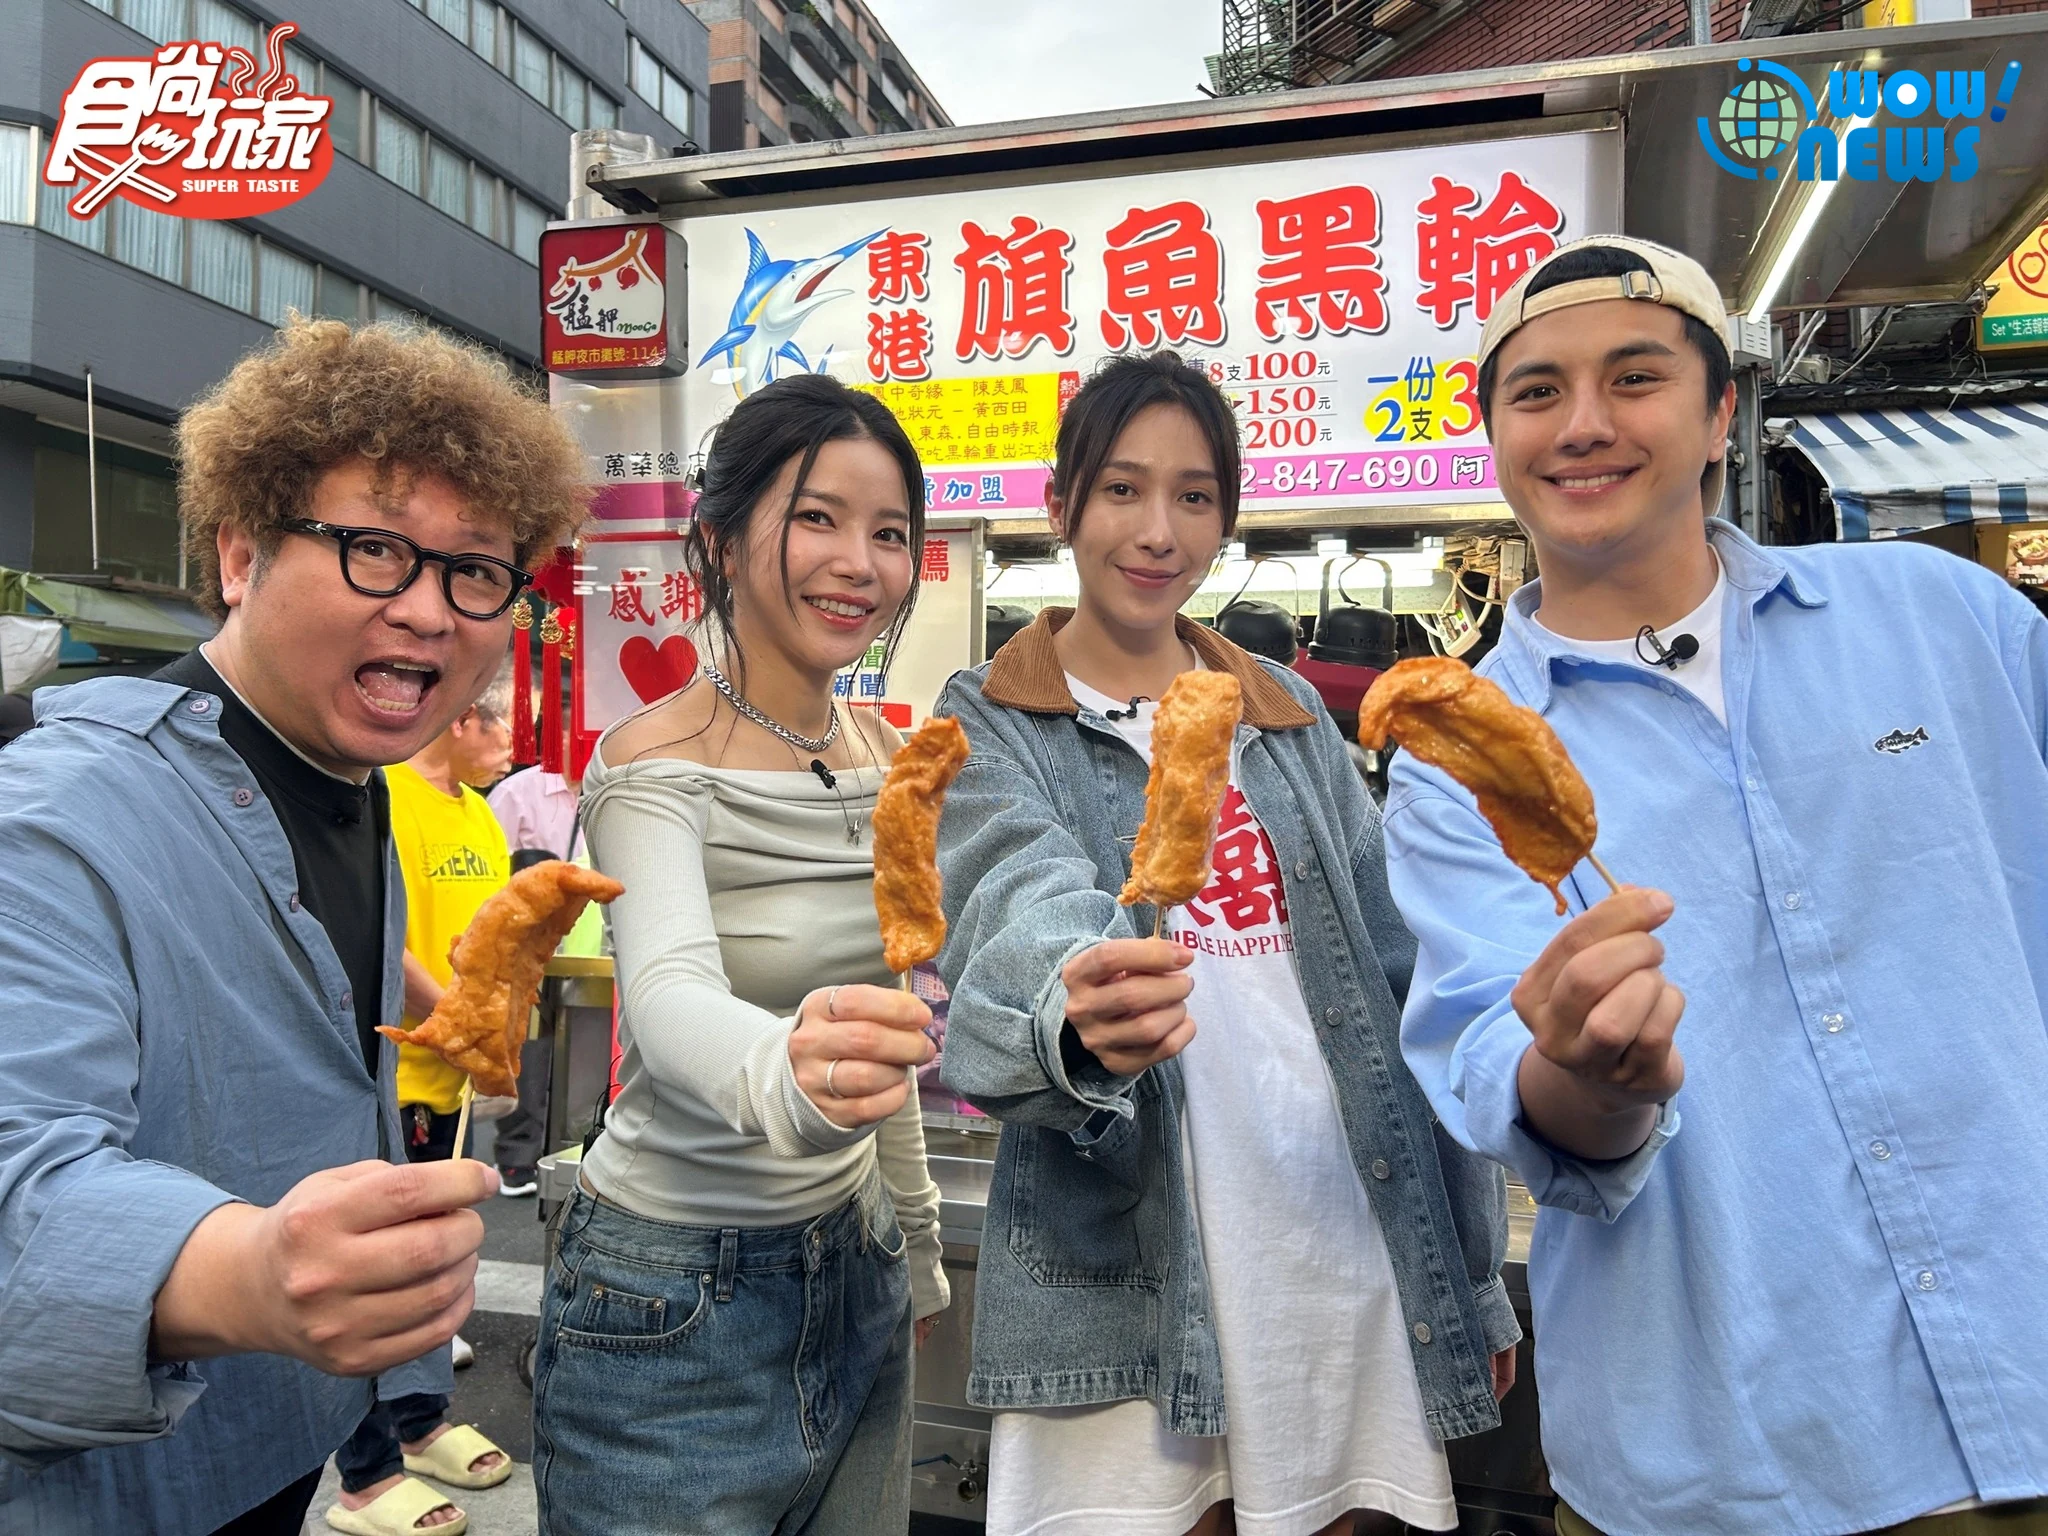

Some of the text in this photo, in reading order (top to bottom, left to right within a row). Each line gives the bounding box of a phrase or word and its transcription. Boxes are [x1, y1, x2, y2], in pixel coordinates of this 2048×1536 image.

[953, 171, 1560, 360] 旗魚黑輪
[551, 285, 618, 333] 艋舺
[867, 231, 930, 378] 東港
[1992, 323, 2006, 336] Set
[973, 377, 1028, 396] 陳美鳳
[1367, 356, 1436, 403] 一份
[973, 401, 1027, 418] 黃西田
[1374, 399, 1433, 443] 2支
[608, 569, 703, 626] 感謝
